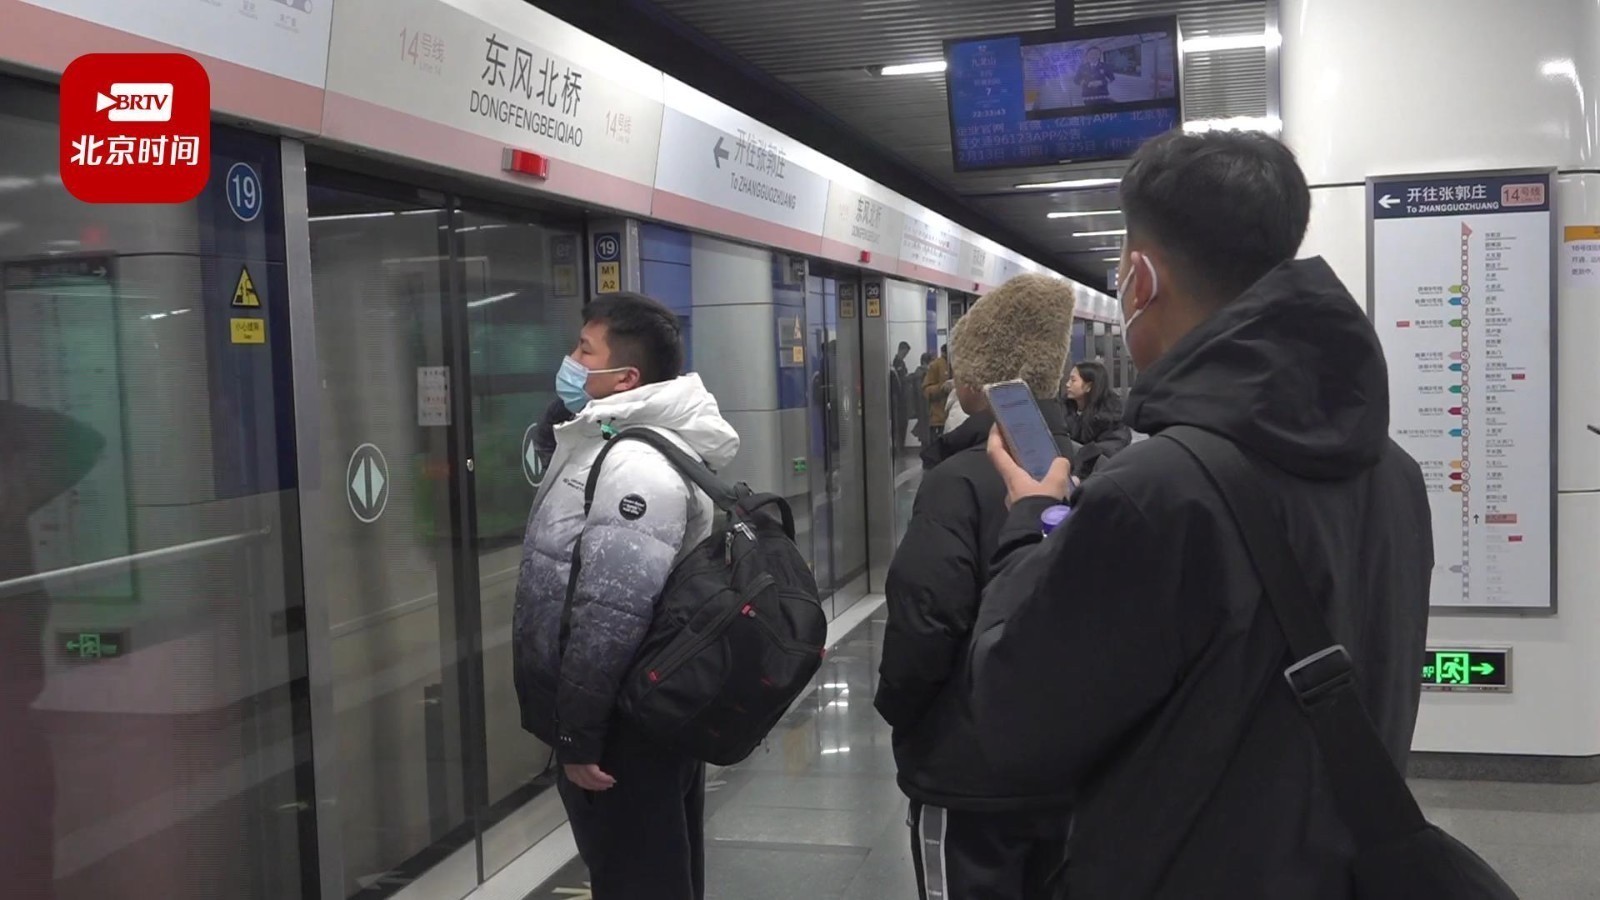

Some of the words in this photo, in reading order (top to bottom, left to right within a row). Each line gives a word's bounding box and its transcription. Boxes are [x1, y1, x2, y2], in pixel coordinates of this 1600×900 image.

[482, 33, 582, 117] 东风北桥
[470, 90, 583, 147] DONGFENGBEIQIAO
[734, 128, 787, 179] 开往张郭庄
[232, 174, 256, 209] 19
[739, 176, 797, 210] ZHANGGUOZHUANG
[1407, 184, 1487, 202] 开往张郭庄
[1406, 205, 1417, 213] To
[1418, 201, 1499, 213] ZHANGGUOZHUANG
[600, 241, 615, 255] 19
[601, 266, 614, 275] M1
[602, 281, 615, 289] A2
